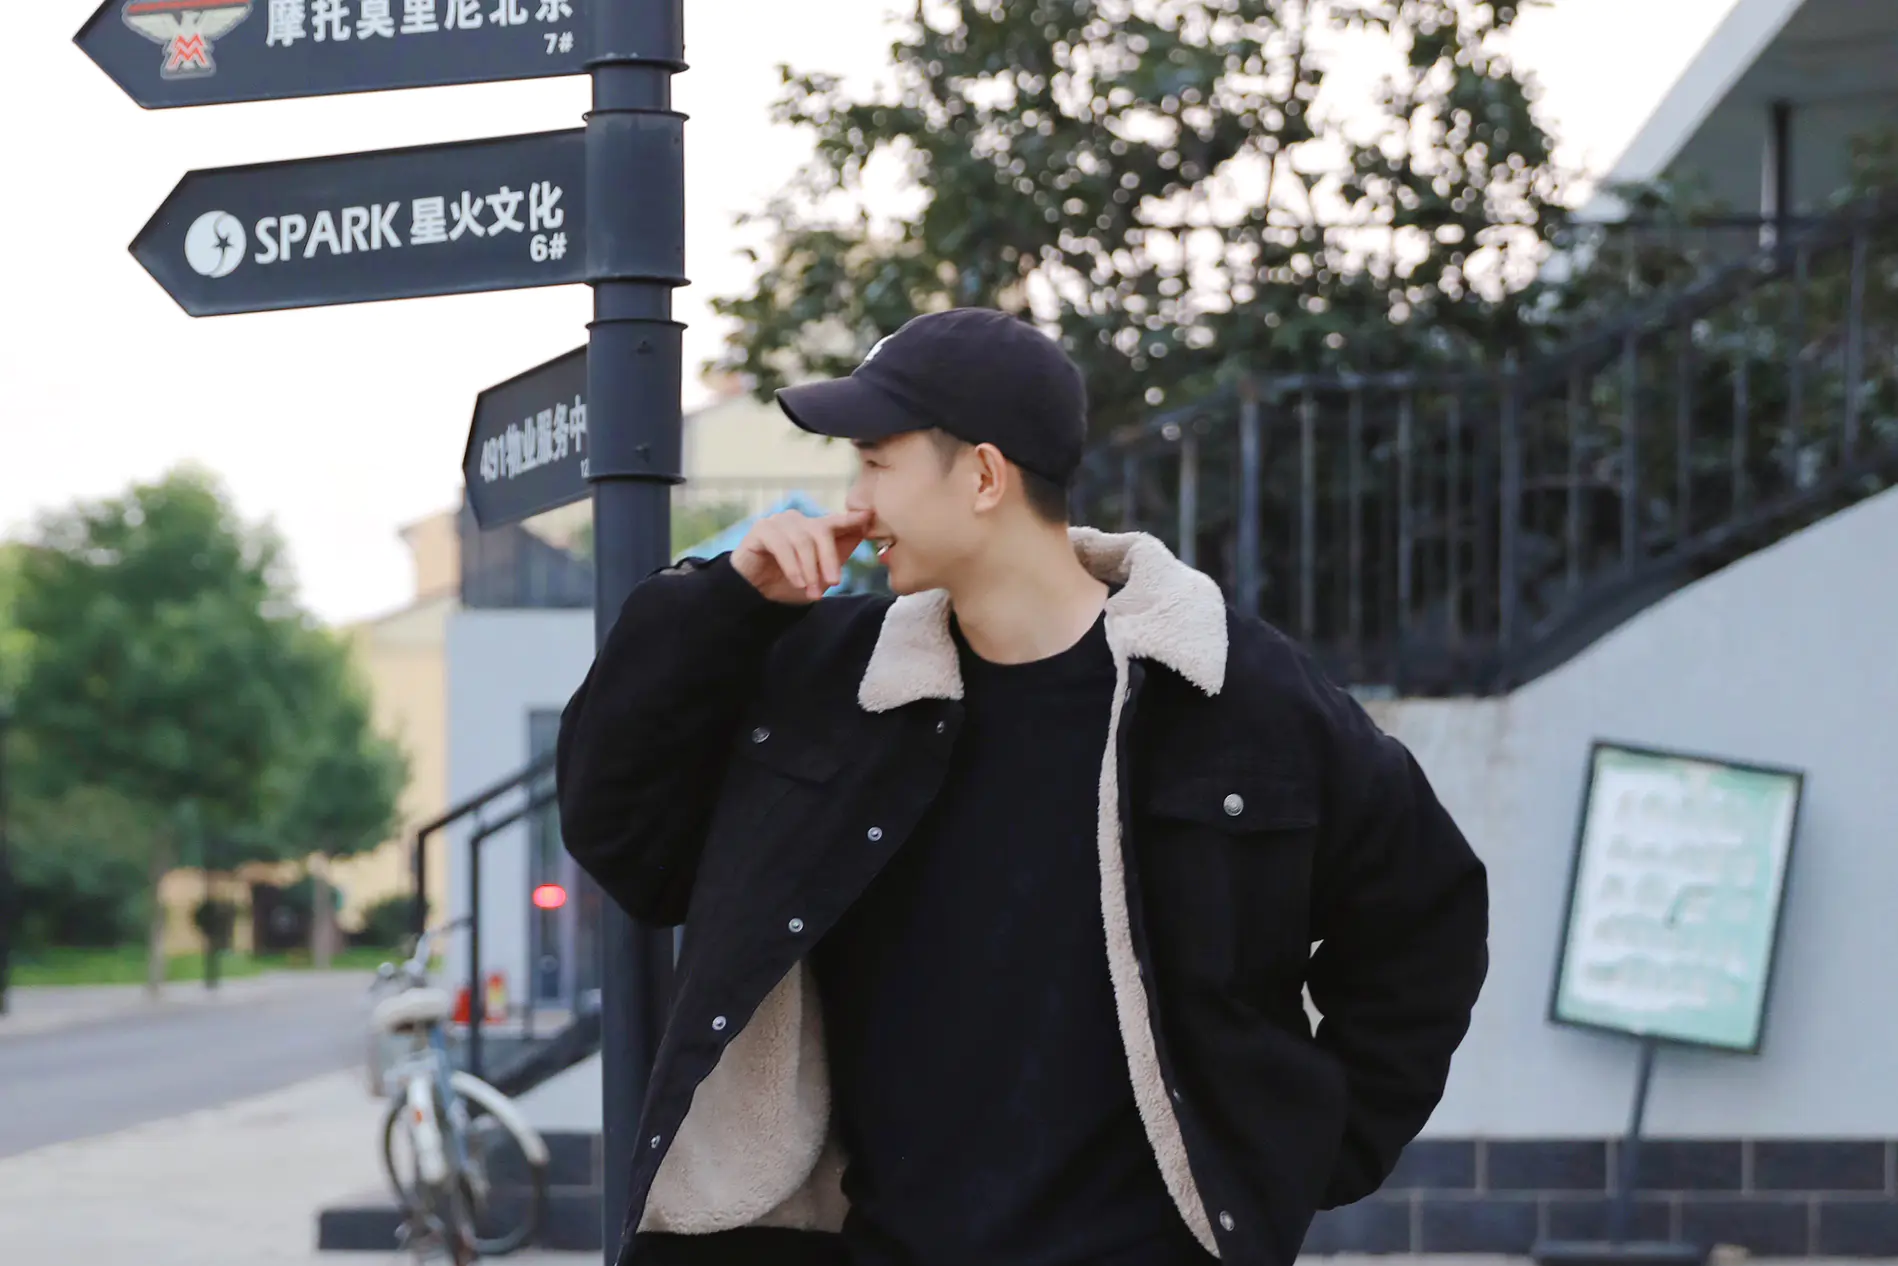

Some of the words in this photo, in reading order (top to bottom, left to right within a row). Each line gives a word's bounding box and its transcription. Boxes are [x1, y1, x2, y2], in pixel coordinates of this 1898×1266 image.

[543, 31, 574, 55] 7#
[254, 201, 402, 265] SPARK
[410, 180, 565, 245] 星火文化
[529, 232, 568, 263] 6#
